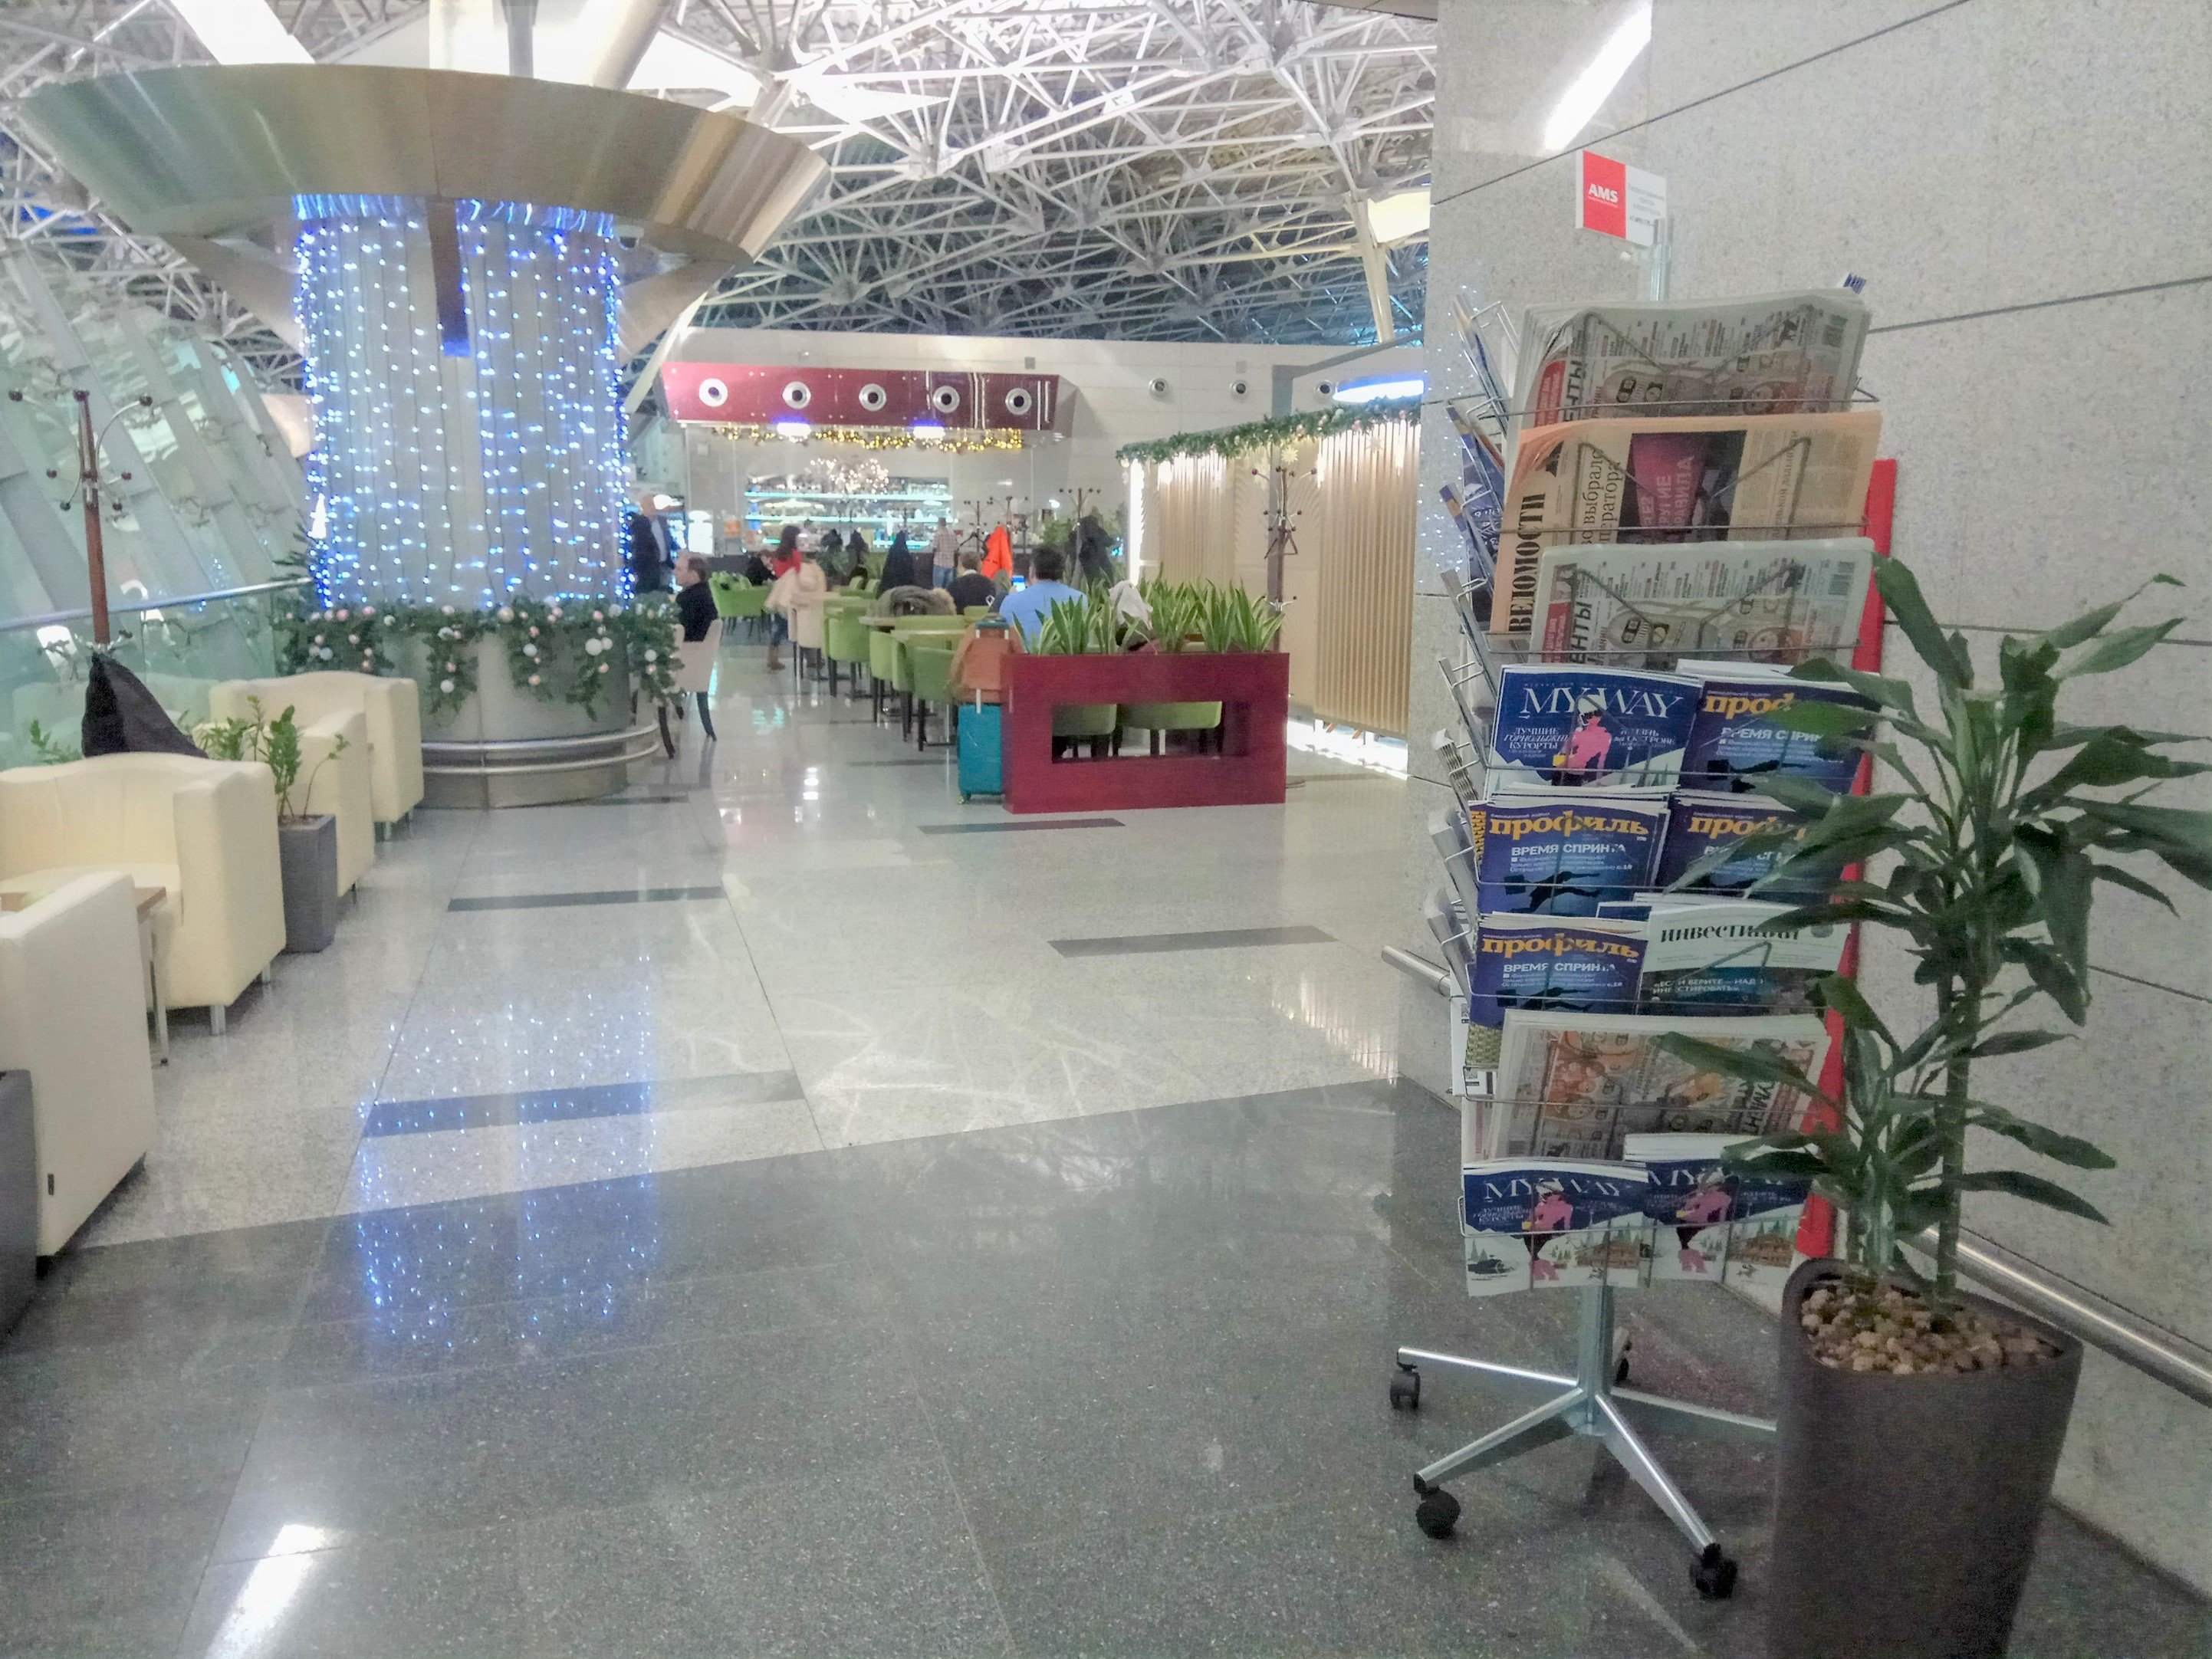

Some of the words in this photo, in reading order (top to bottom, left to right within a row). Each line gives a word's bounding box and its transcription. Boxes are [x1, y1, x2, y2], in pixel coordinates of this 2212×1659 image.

[1588, 183, 1618, 204] AMS
[1508, 493, 1546, 632] ВЕДОМОСТИ
[1489, 810, 1649, 840] профиль
[1511, 844, 1559, 856] ВРЕМЯ
[1481, 932, 1639, 958] профиль
[1504, 963, 1549, 973] ВРЕМЯ
